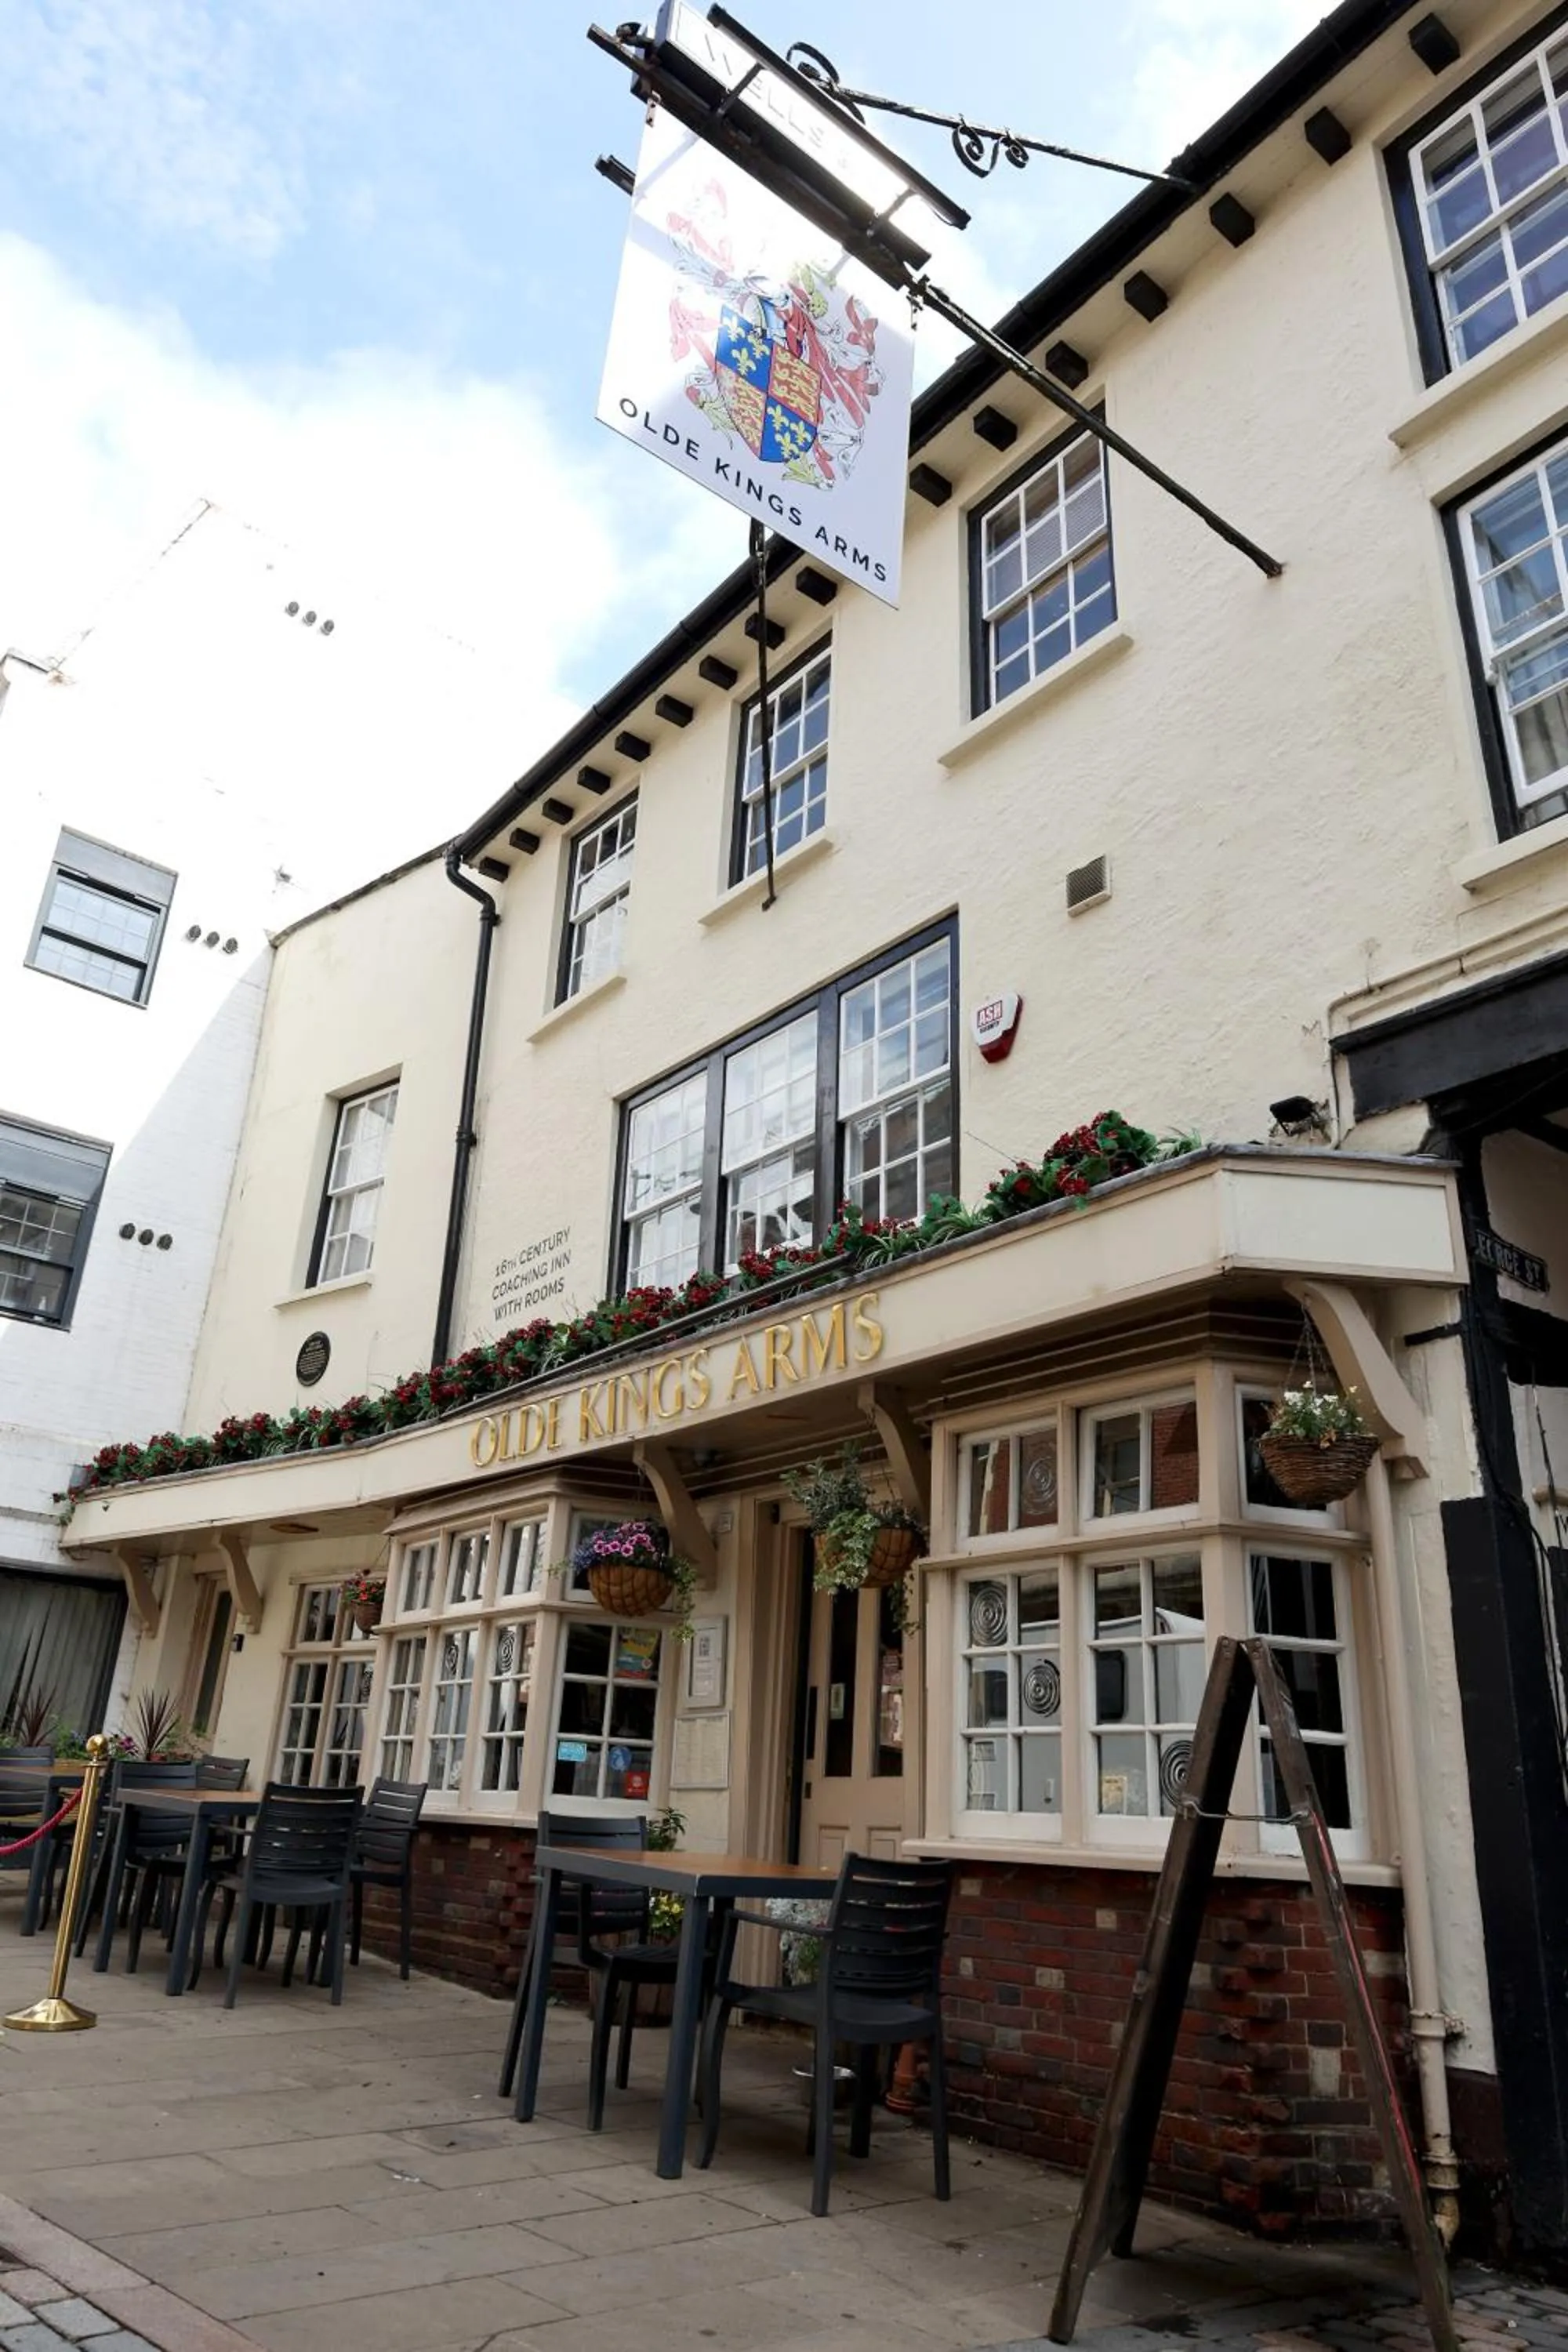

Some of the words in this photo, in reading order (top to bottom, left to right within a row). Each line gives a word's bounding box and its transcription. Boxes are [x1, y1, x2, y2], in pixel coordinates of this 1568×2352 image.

[619, 397, 700, 461] OLDE
[715, 457, 802, 526] KINGS
[815, 525, 887, 582] ARMS
[518, 1225, 571, 1265] CENTURY
[492, 1261, 548, 1301] COACHING
[550, 1248, 572, 1274] INN
[494, 1298, 523, 1322] WITH
[524, 1276, 565, 1308] ROOMS
[472, 1396, 563, 1468] OLDE
[579, 1348, 711, 1443] KINGS
[729, 1292, 884, 1401] ARMS
